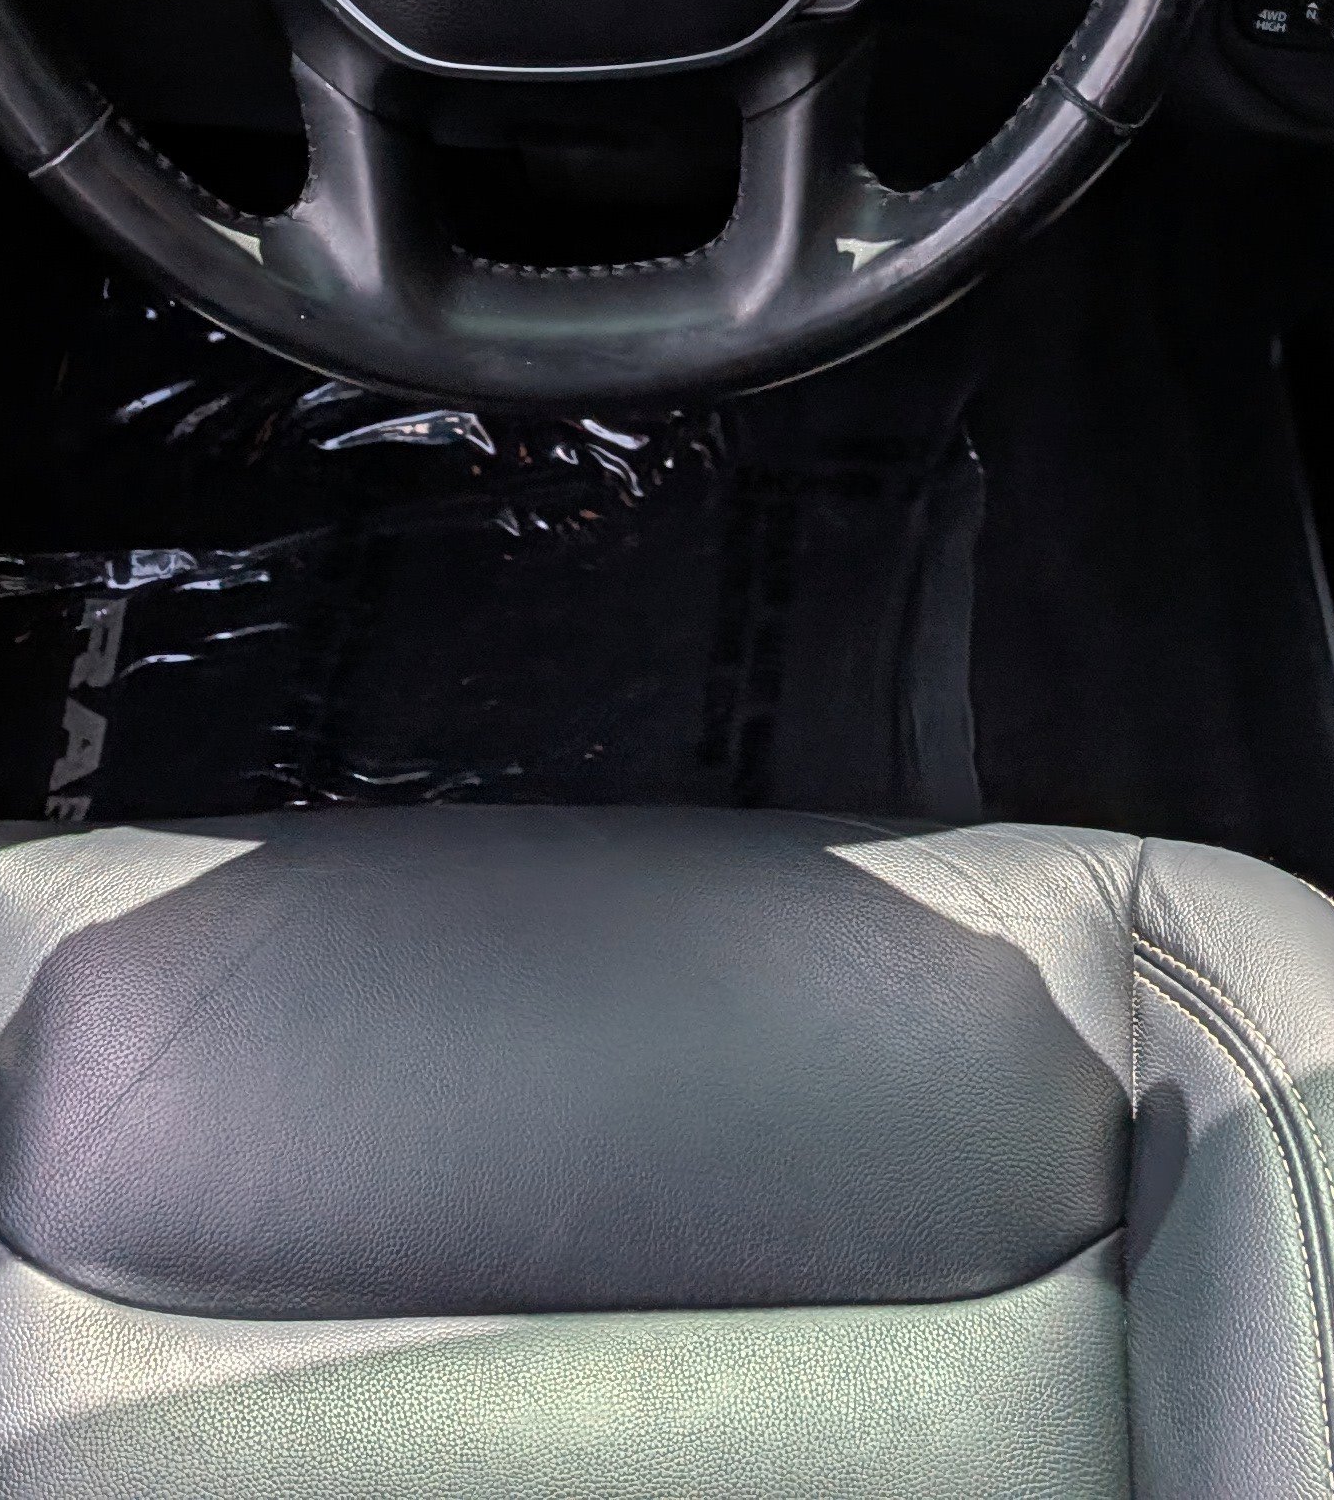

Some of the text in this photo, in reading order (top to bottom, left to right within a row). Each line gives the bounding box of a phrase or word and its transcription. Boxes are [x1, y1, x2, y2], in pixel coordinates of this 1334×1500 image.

[1258, 9, 1288, 22] 4WD
[1305, 8, 1318, 20] N
[1255, 19, 1287, 33] HIGH
[45, 597, 129, 823] RA
